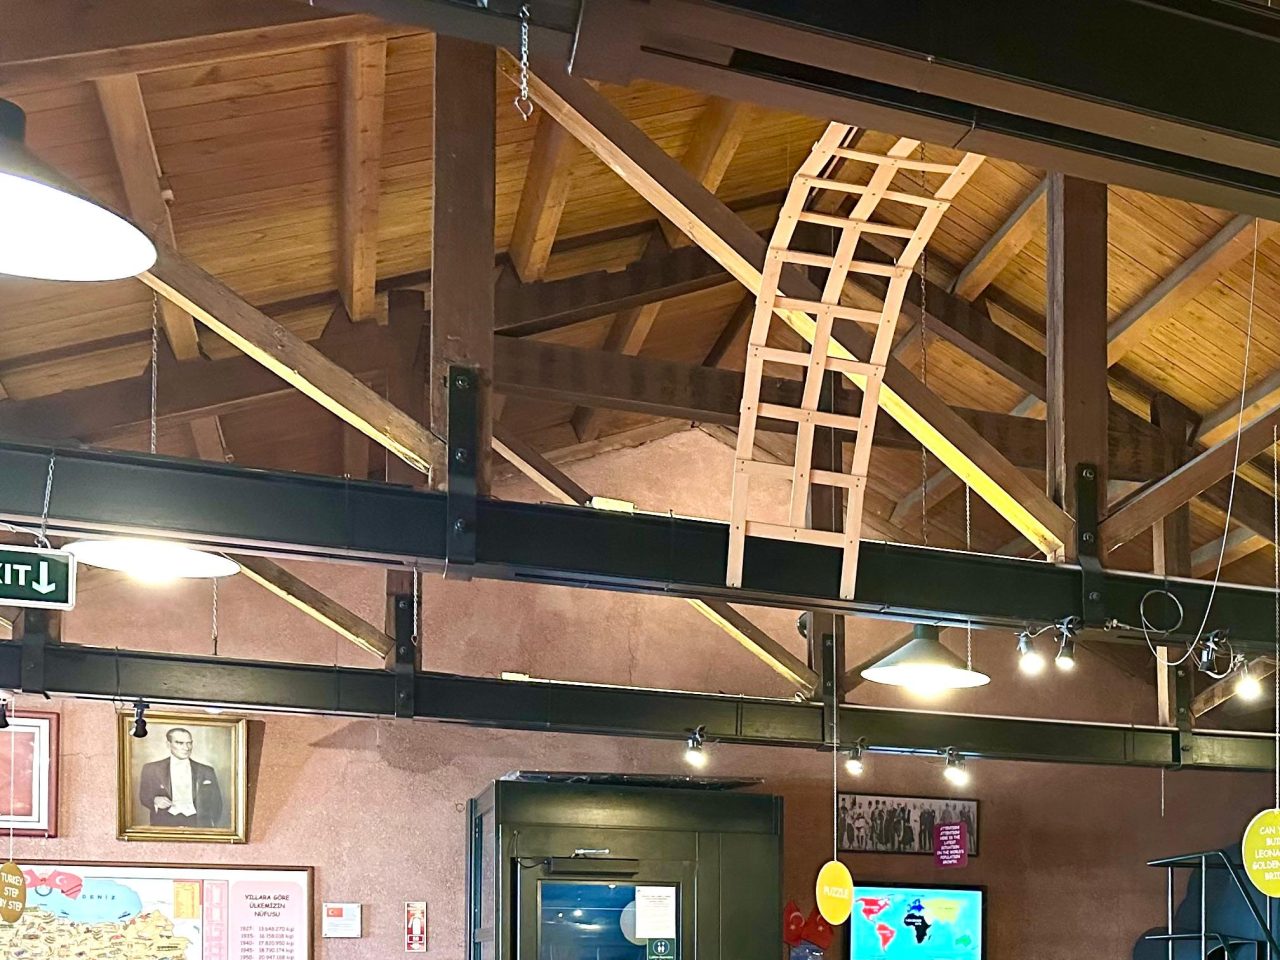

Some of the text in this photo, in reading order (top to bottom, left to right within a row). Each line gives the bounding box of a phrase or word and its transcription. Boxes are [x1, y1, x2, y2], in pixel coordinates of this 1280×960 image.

[0, 562, 32, 586] IT
[1259, 826, 1276, 835] CAN
[1, 872, 24, 886] TURKEY
[3, 886, 20, 898] STEP
[823, 885, 850, 899] PUZZLE
[7, 900, 23, 912] STEP
